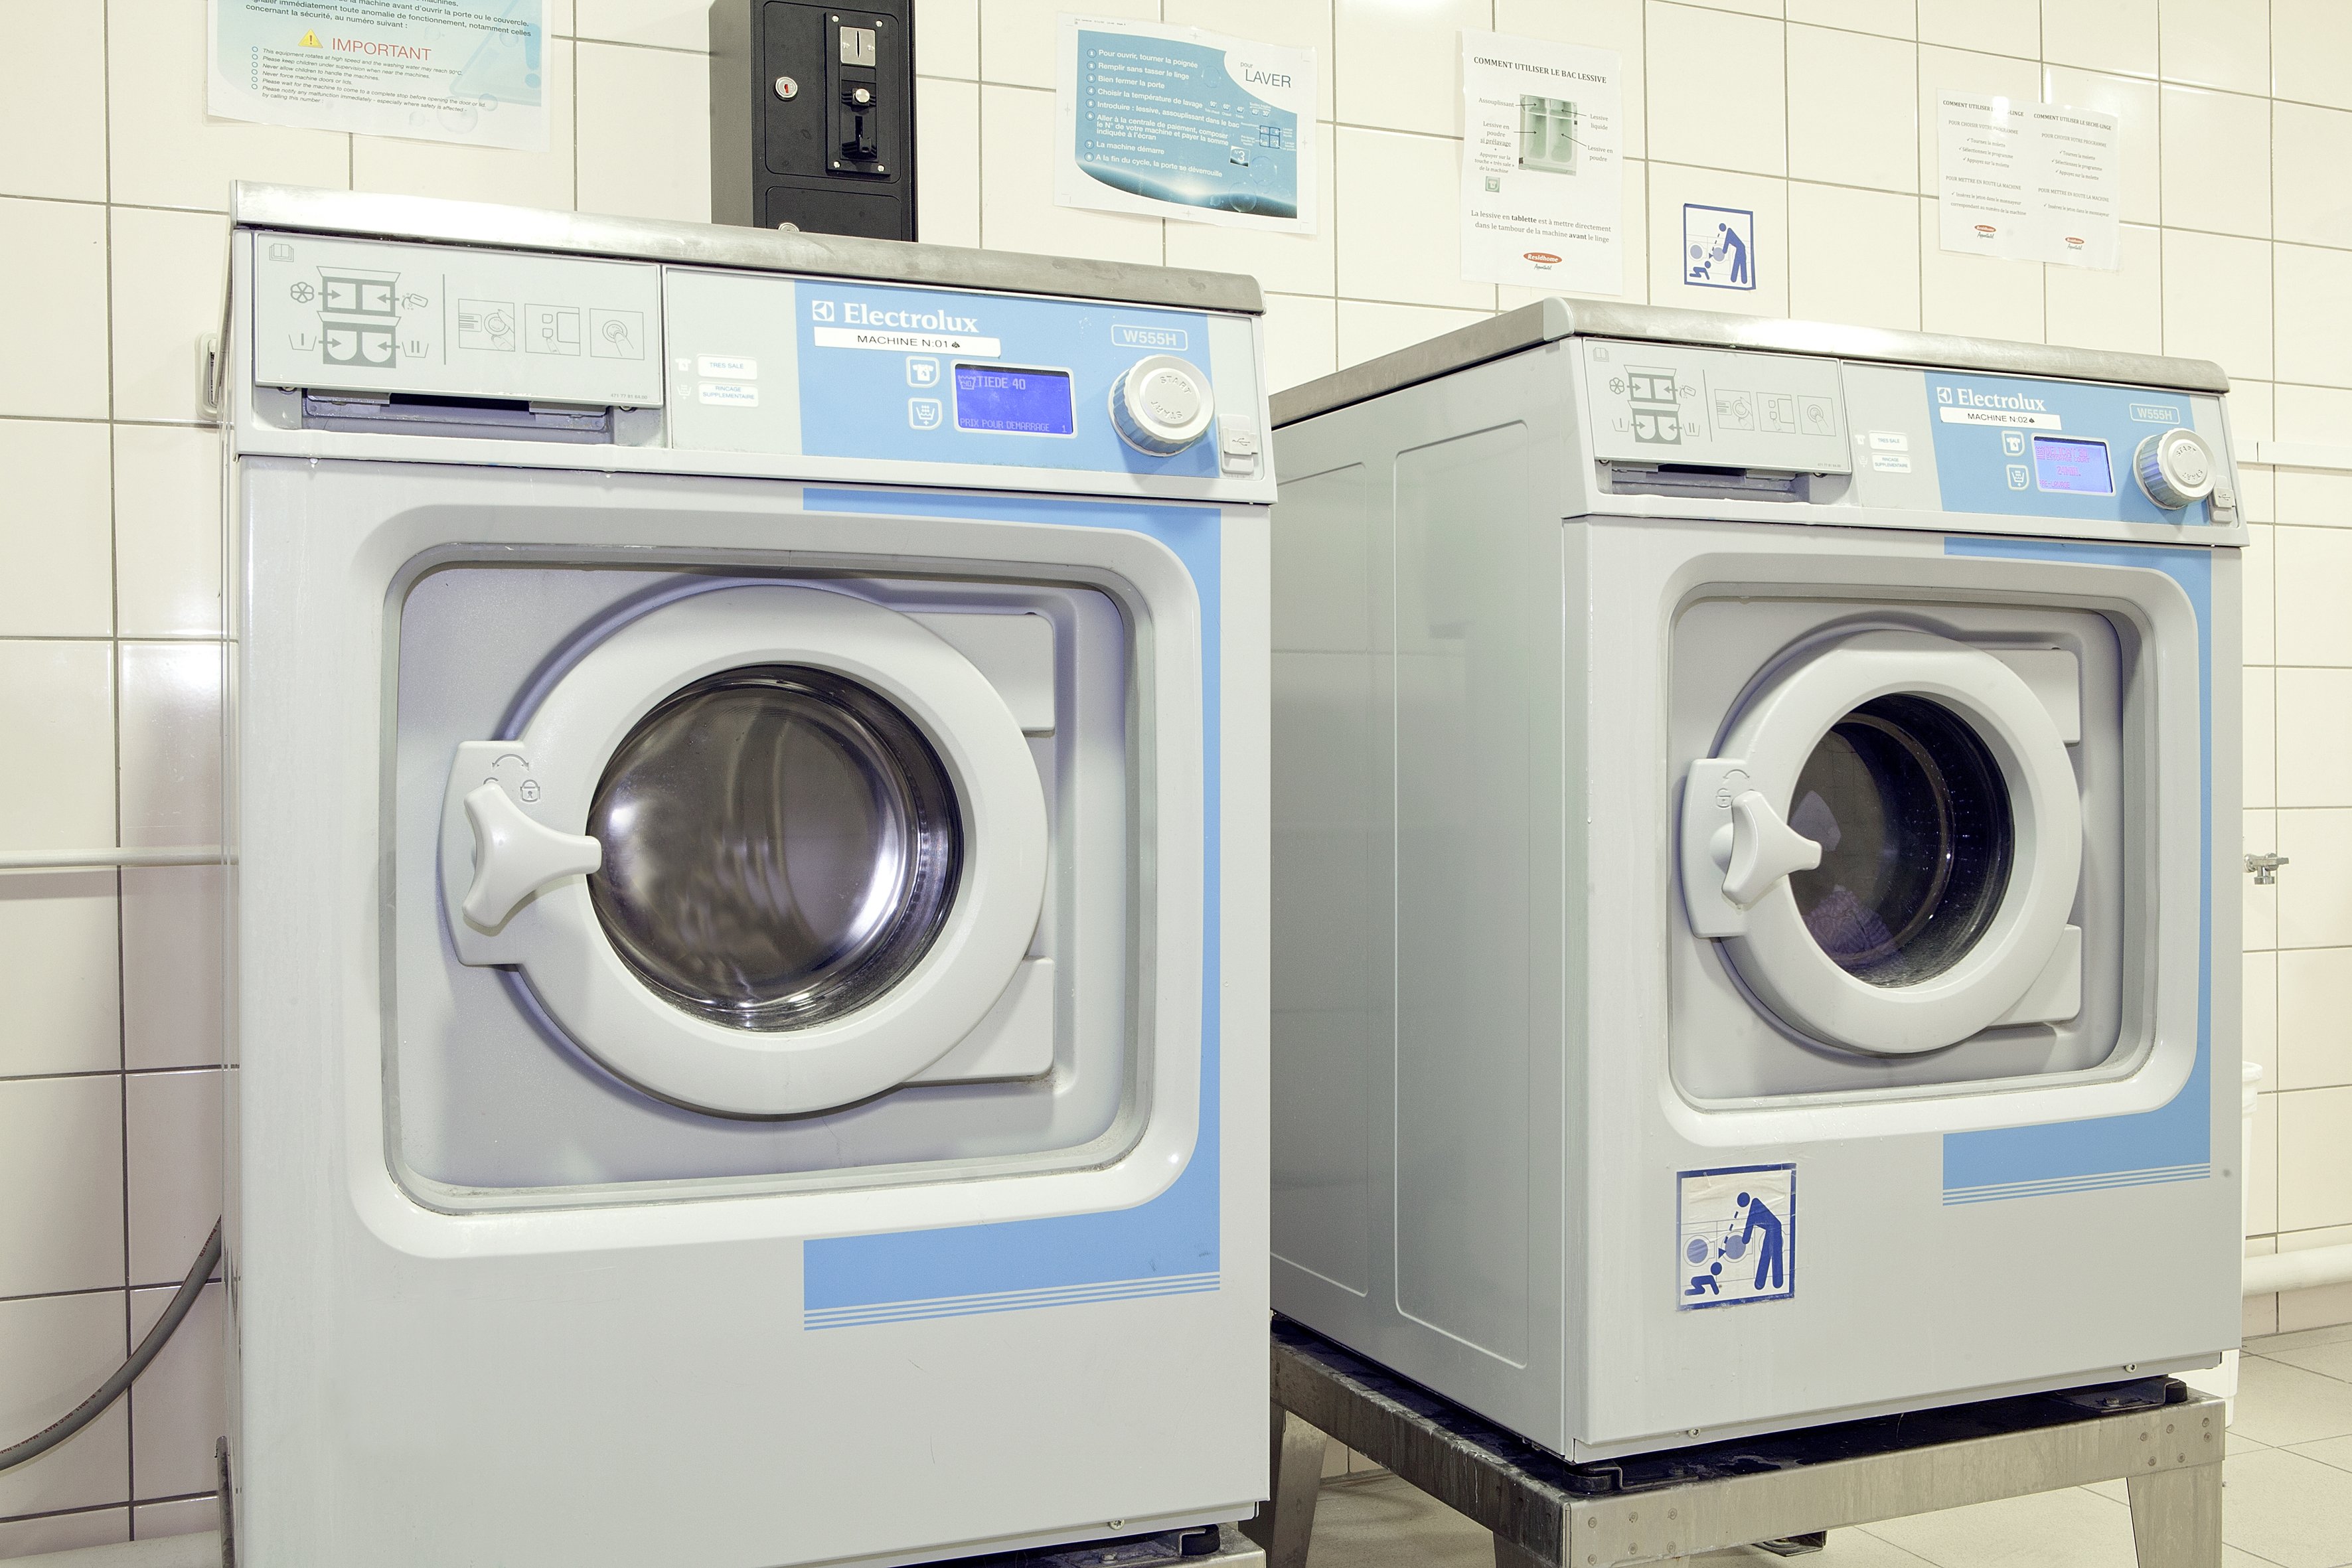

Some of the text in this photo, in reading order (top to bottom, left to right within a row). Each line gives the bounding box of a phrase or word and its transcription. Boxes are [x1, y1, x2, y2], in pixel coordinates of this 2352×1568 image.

[246, 5, 288, 15] concernant
[279, 1, 337, 10] immédiatement
[408, 15, 466, 27] fonctionnement,
[469, 23, 509, 33] notamment
[493, 17, 528, 26] couvercle.
[333, 38, 431, 61] IMPORTANT
[1172, 59, 1198, 68] poignée
[1474, 56, 1512, 69] COMMENT
[1515, 63, 1549, 75] UTILISER
[1561, 70, 1576, 79] BAC
[1578, 73, 1607, 84] LESSIVE
[1174, 71, 1189, 80] linge
[1245, 68, 1291, 88] LAVER
[1131, 92, 1171, 102] température
[1182, 99, 1202, 108] lavage
[1097, 101, 1130, 110] Introduire
[1162, 110, 1204, 121] assouplissant
[1097, 128, 1126, 137] indiquée
[1134, 131, 1156, 140] l'écran
[1129, 118, 1155, 127] centrale
[1167, 123, 1197, 133] paiement,
[1199, 129, 1228, 139] composer
[1145, 127, 1172, 136] machine
[1137, 145, 1164, 154] démarre
[1188, 166, 1222, 177] déverrouille
[1575, 222, 1610, 232] directement
[1528, 254, 1559, 262] Residhome
[843, 302, 979, 333] Electrolux
[858, 335, 948, 348] MACHINE N:01
[1123, 329, 1177, 346] W555H
[977, 376, 1026, 390] TIEDE 40
[1160, 375, 1192, 394] START
[1957, 388, 2047, 412] Electrolux
[1150, 400, 1183, 420] START
[2137, 408, 2173, 420] W555H
[1968, 413, 2007, 422] MACHINE
[960, 418, 979, 428] PRIX
[982, 419, 1004, 429] POUR
[1006, 422, 1050, 431] DEMARRAGE
